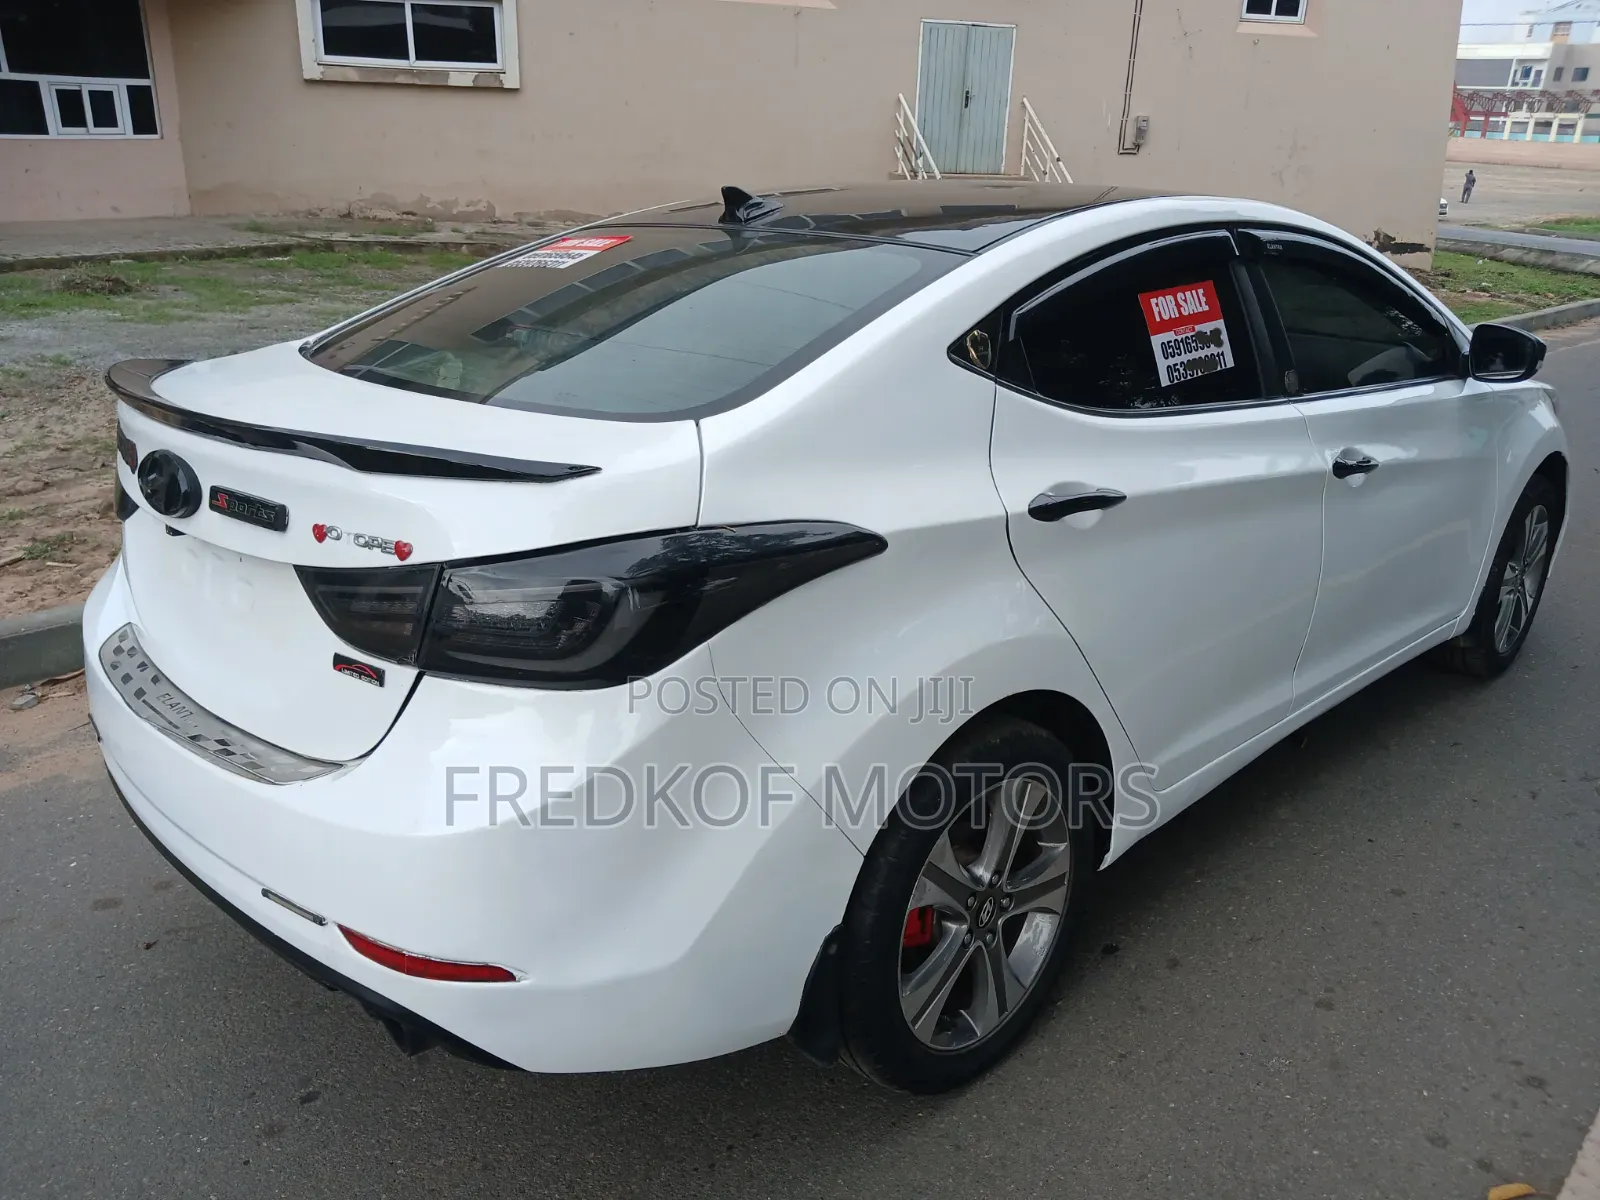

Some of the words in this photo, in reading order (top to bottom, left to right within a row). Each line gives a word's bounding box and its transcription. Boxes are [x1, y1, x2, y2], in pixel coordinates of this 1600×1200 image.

[1150, 294, 1179, 322] FOR
[1177, 288, 1209, 316] SALE
[212, 493, 275, 523] Sports
[341, 667, 360, 679] LIMITED
